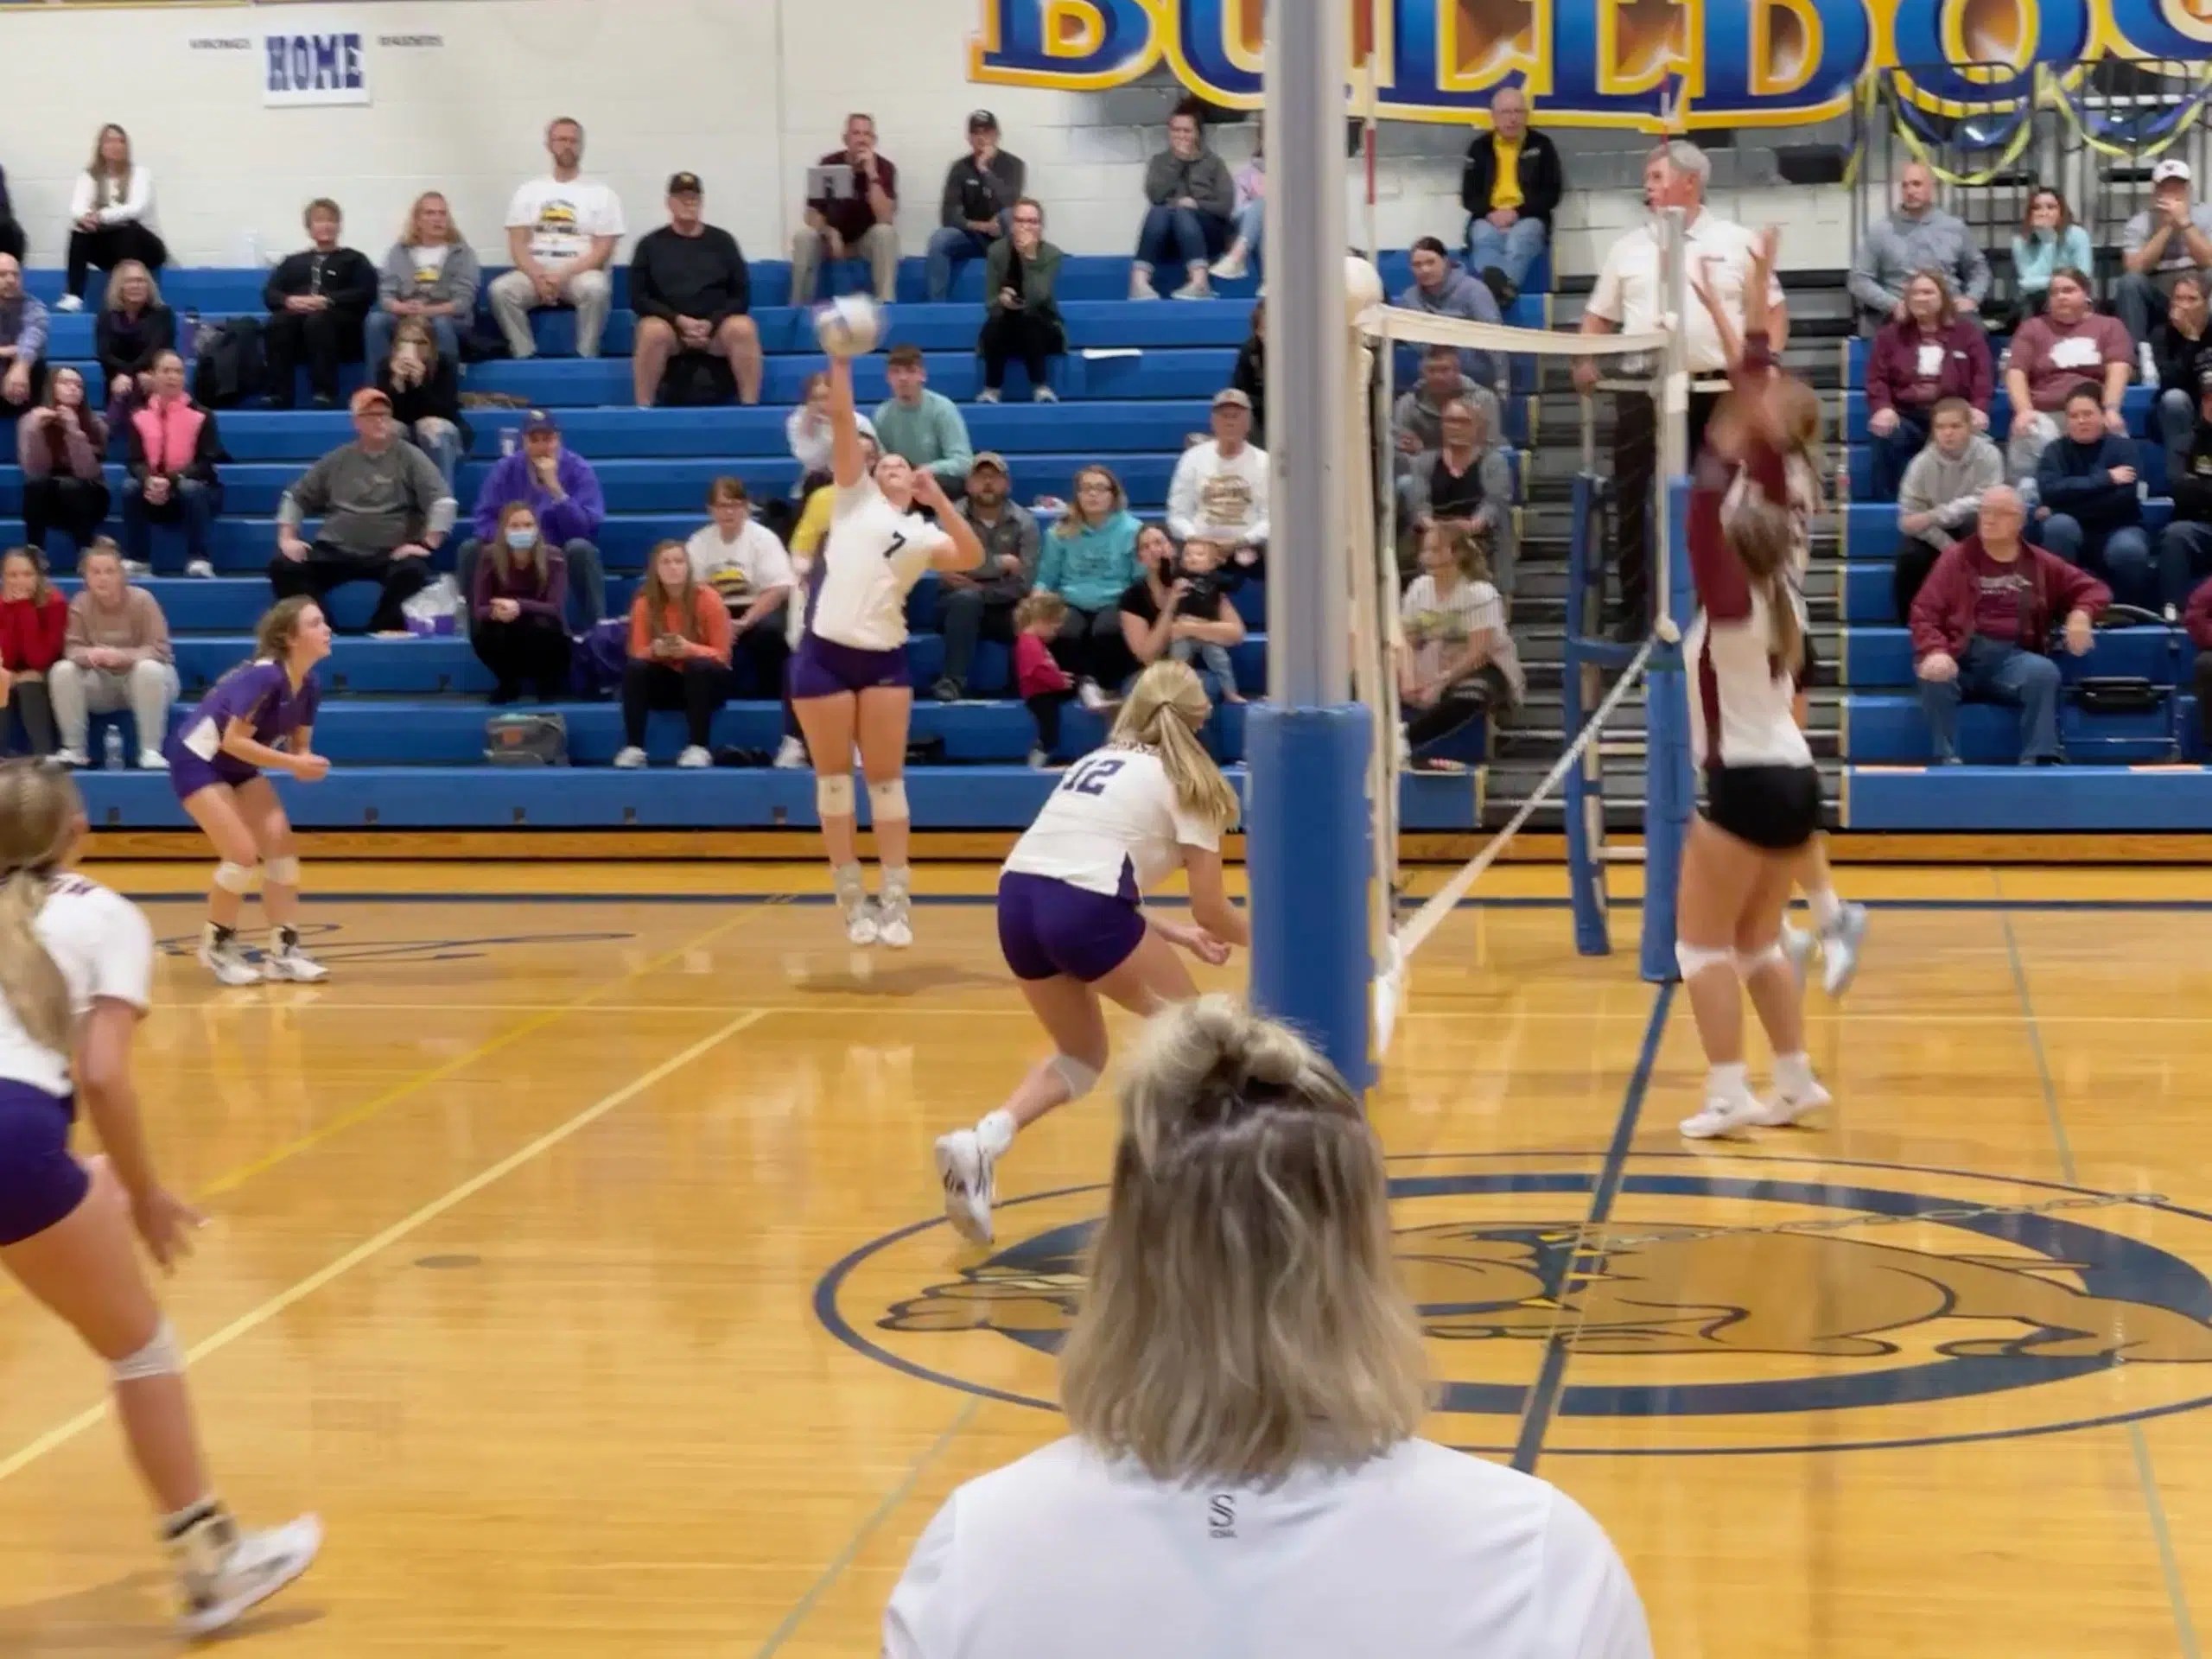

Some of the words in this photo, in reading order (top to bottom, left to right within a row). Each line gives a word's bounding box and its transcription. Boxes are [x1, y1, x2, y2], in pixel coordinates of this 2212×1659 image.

[266, 34, 362, 90] HOME
[882, 530, 906, 560] 7
[1063, 759, 1126, 797] 12
